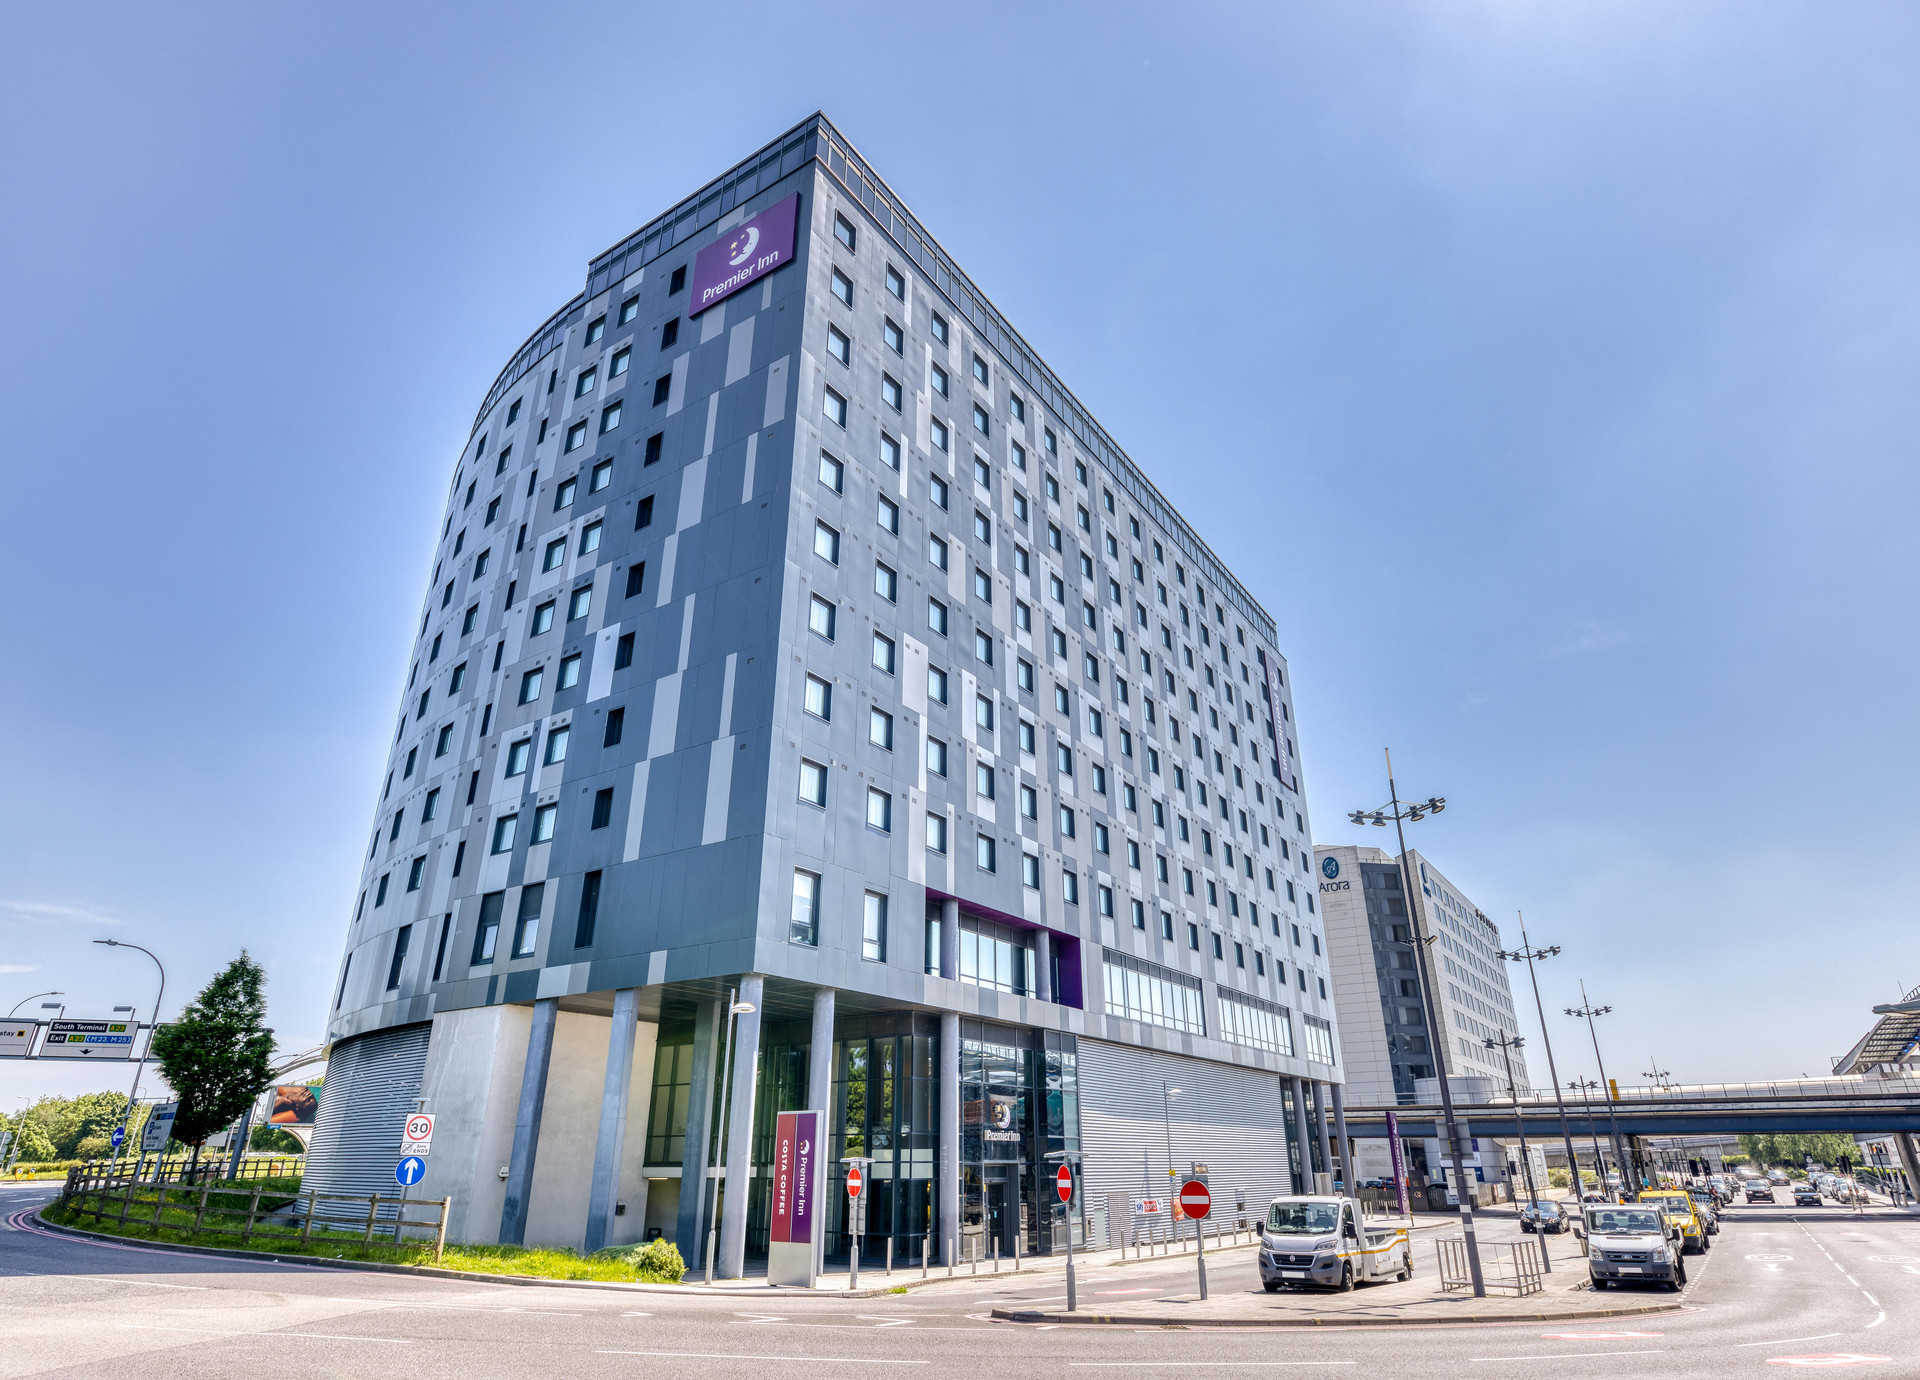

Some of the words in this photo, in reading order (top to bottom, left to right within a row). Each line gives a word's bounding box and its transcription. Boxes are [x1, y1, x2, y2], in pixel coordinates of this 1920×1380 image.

[703, 264, 755, 302] Premier
[758, 251, 778, 271] Inn
[1274, 693, 1284, 748] Premier
[1319, 880, 1350, 893] Arora
[410, 1123, 428, 1134] 30
[985, 1130, 1010, 1141] Premier
[1011, 1131, 1020, 1141] Inn
[798, 1158, 808, 1198] Premier
